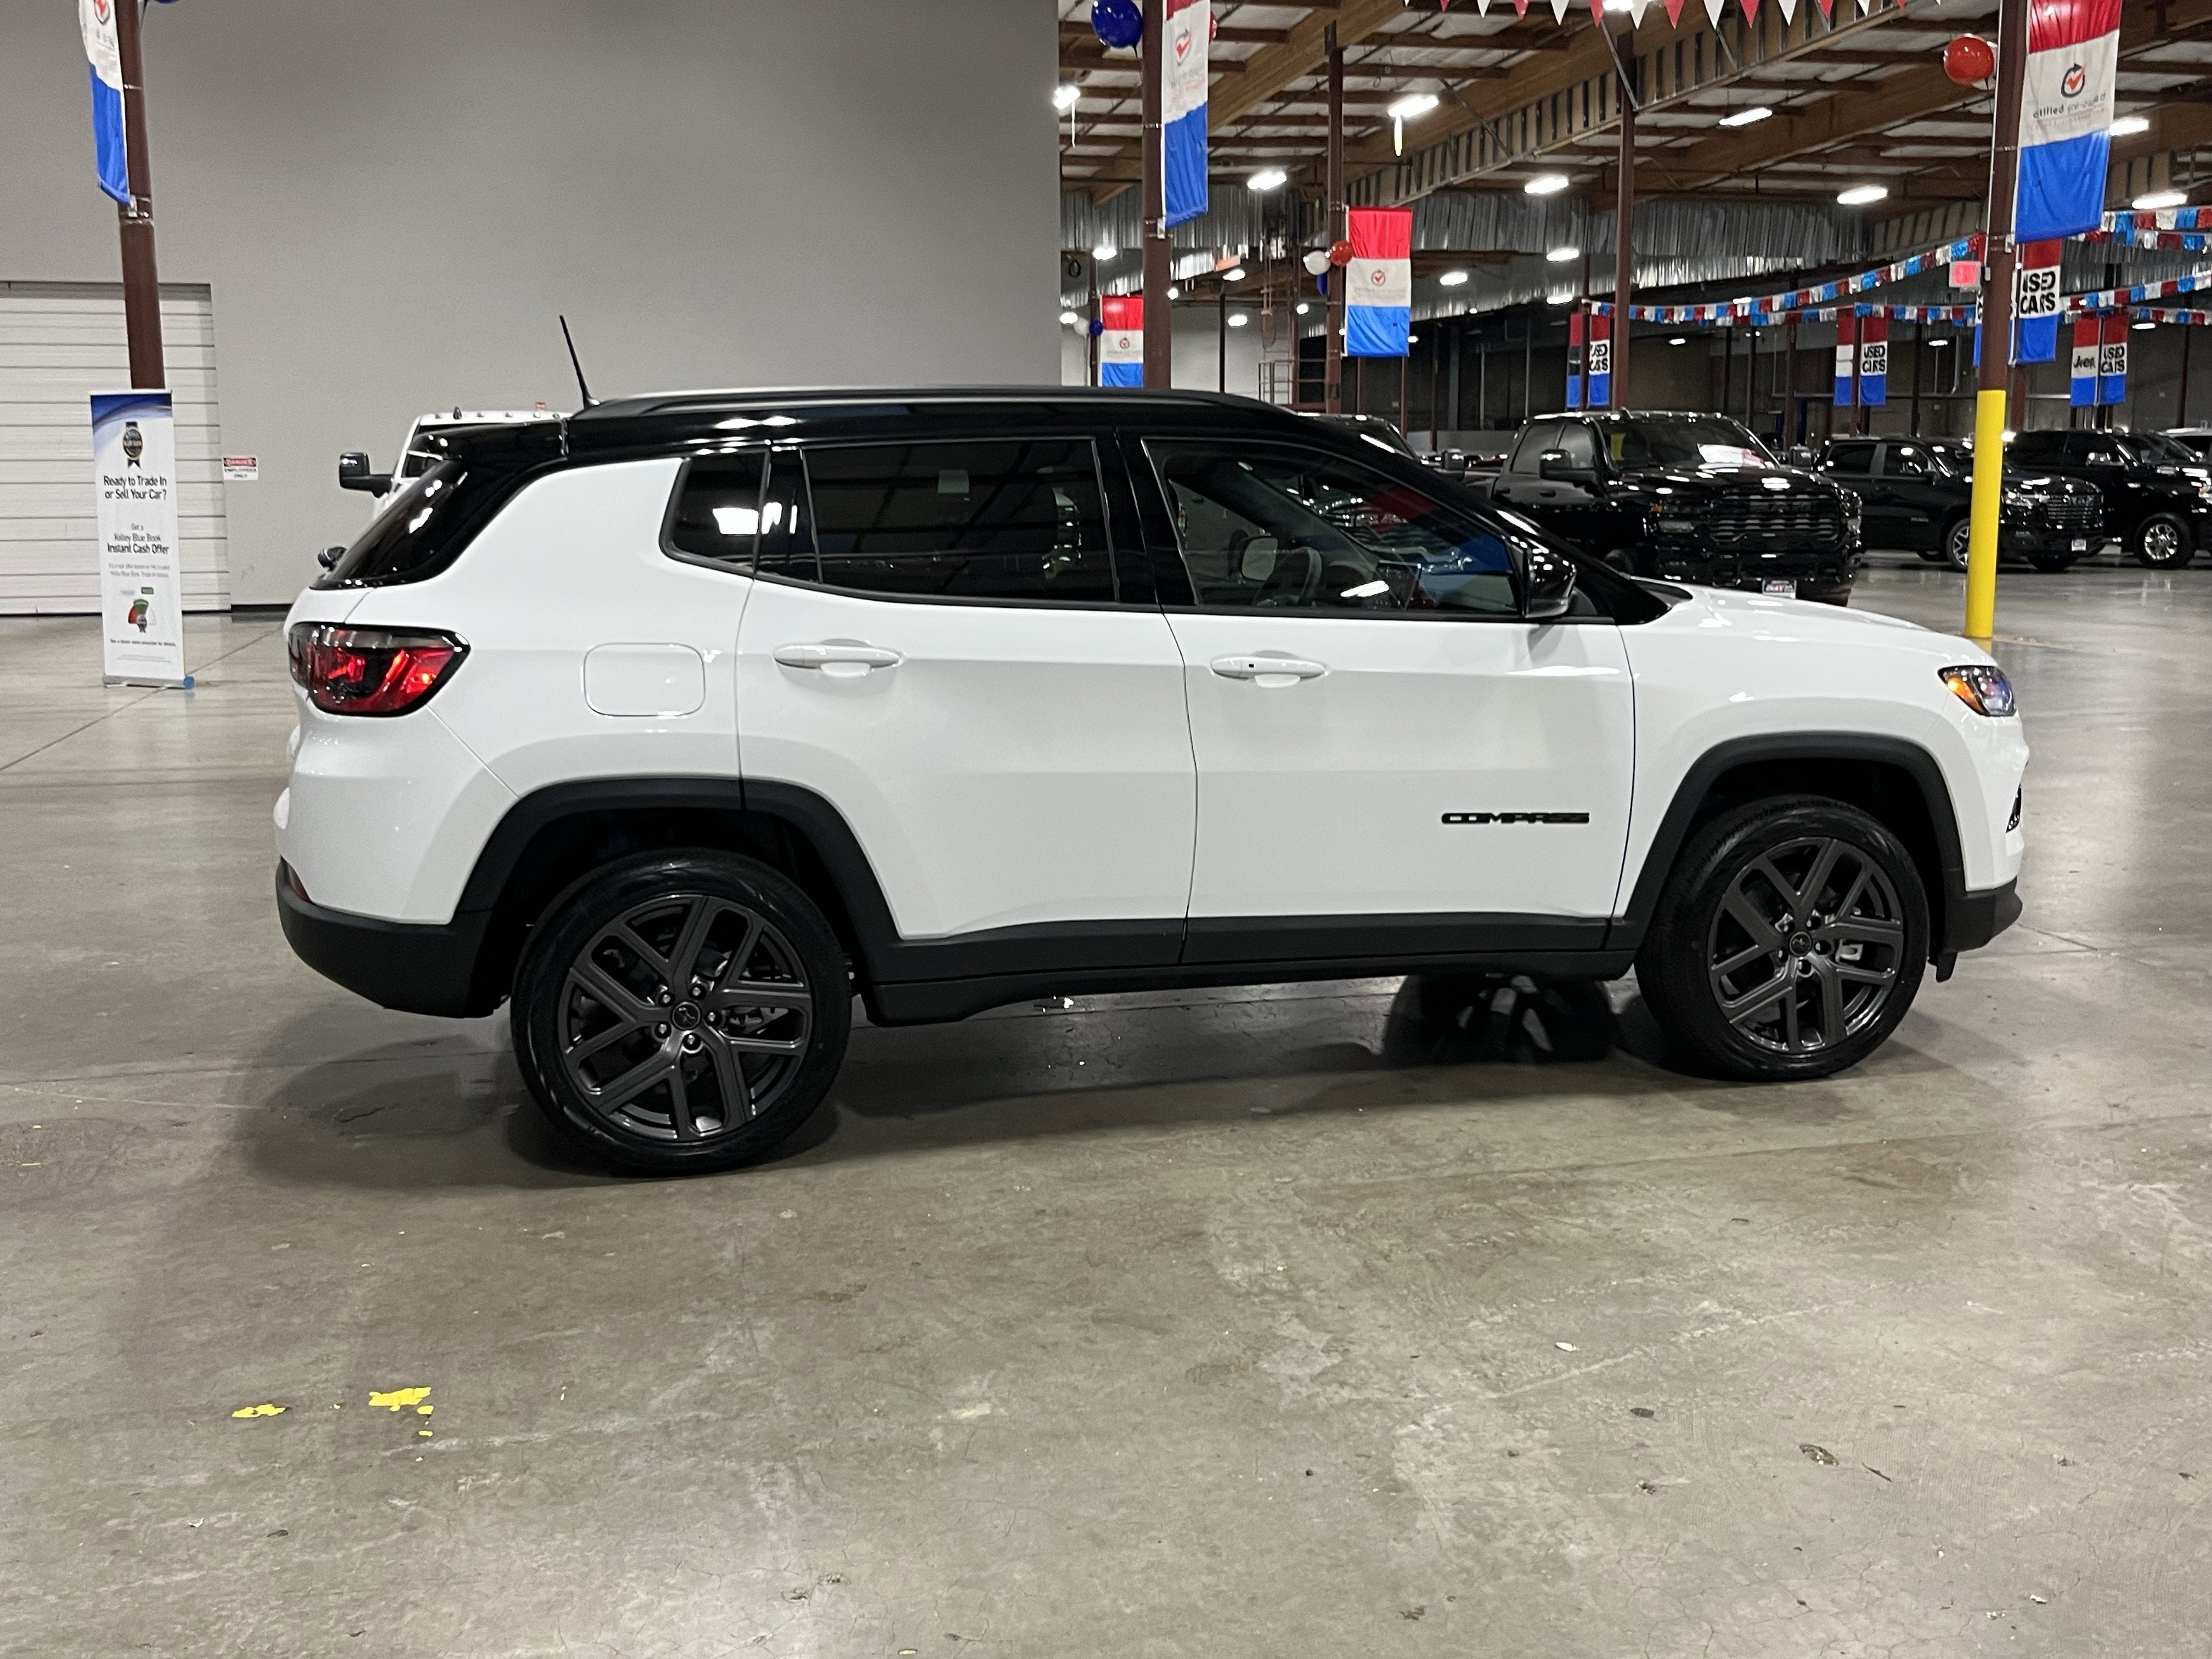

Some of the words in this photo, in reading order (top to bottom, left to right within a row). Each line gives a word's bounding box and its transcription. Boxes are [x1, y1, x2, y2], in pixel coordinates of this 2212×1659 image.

[104, 475, 127, 489] Ready
[128, 476, 136, 486] to
[137, 475, 158, 486] Trade
[160, 476, 167, 486] In
[115, 489, 129, 499] Sell
[131, 489, 148, 499] Your
[107, 543, 132, 553] Instant
[133, 543, 150, 554] Cash
[152, 543, 170, 554] Offer
[1441, 812, 1590, 823] COMPASS
